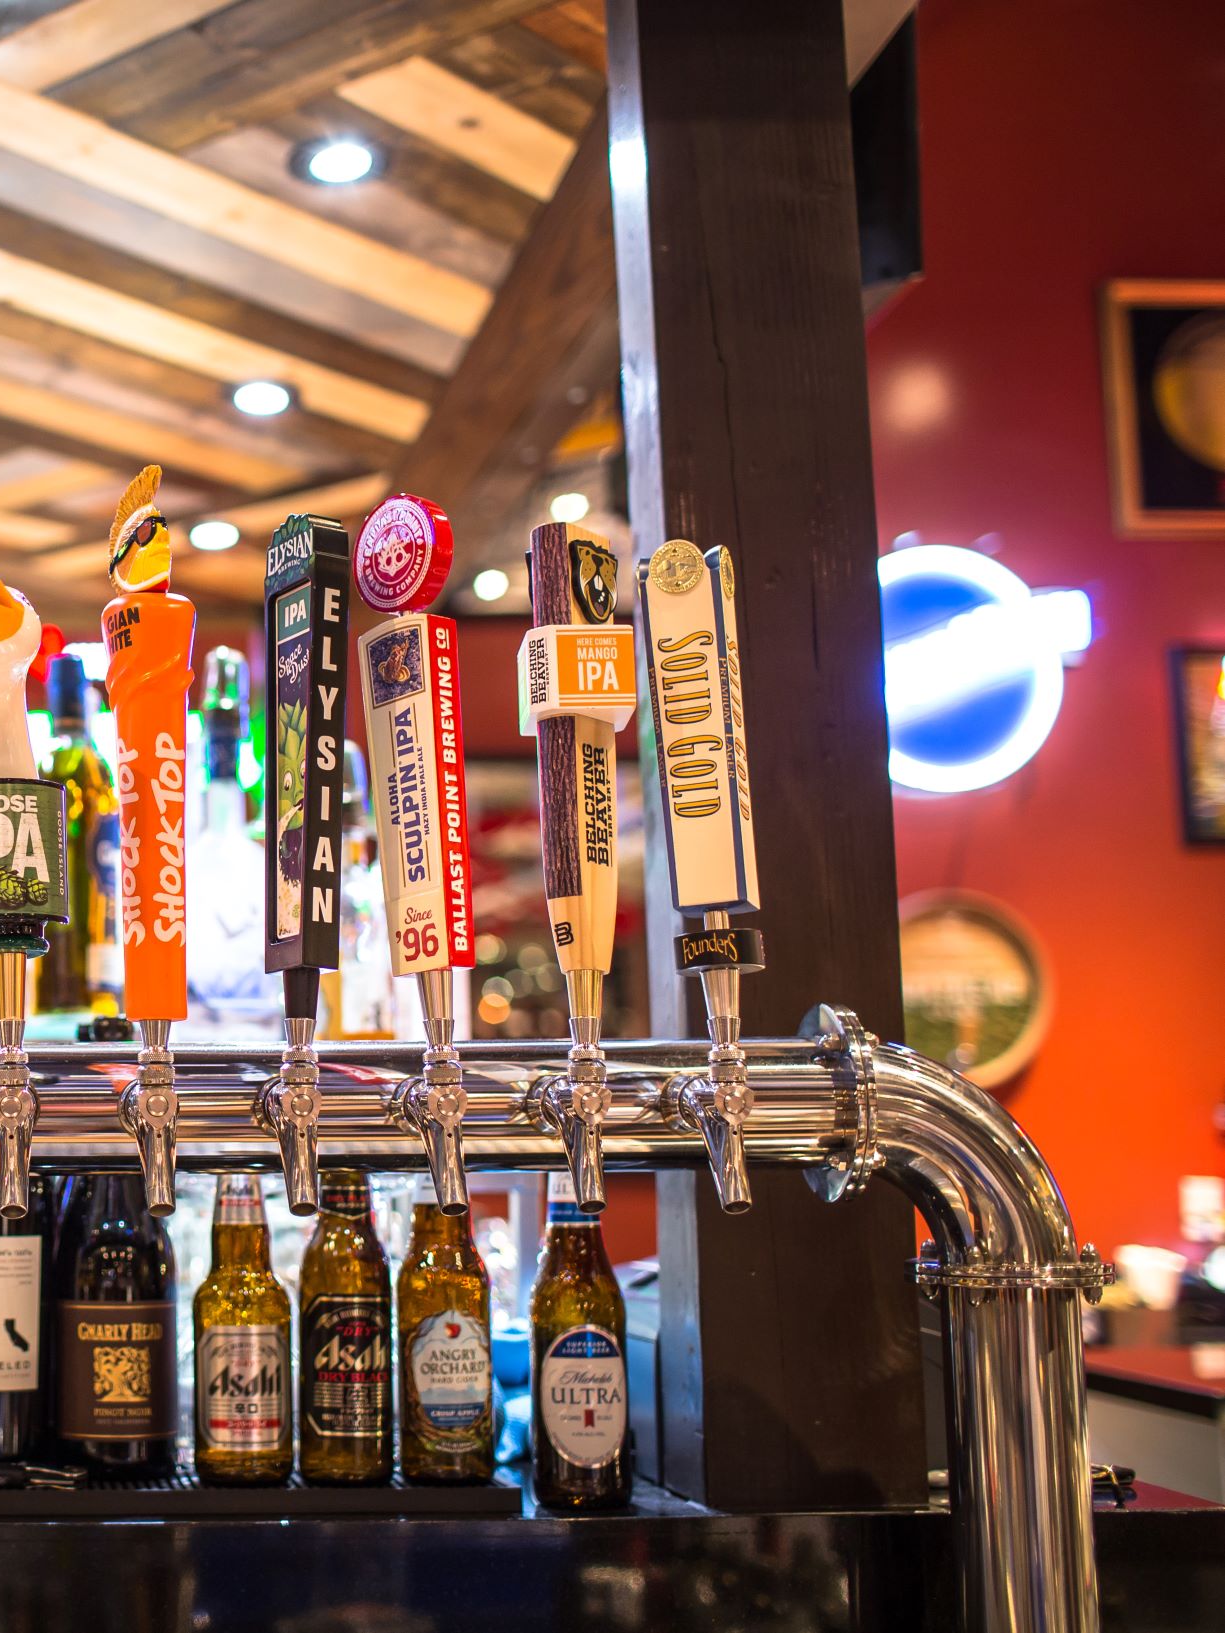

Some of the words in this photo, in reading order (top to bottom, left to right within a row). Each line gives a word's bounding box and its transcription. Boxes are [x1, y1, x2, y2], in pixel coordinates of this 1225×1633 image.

[268, 529, 313, 577] ELYSIAN
[396, 549, 424, 593] COMPANY
[365, 567, 394, 596] BREWING
[107, 606, 140, 634] GIAN
[284, 599, 307, 628] IPA
[278, 643, 303, 679] Space
[435, 627, 450, 650] CO
[576, 637, 593, 646] HERE
[594, 637, 617, 646] COMES
[577, 647, 618, 660] MANGO
[290, 648, 310, 684] Dust
[529, 639, 538, 705] BELCHING
[537, 637, 547, 703] BEAVER
[578, 661, 620, 691] IPA
[657, 630, 714, 725] SOLID
[395, 707, 415, 757] IPA
[438, 656, 458, 765] BREWING
[647, 667, 662, 736] PREMIUM
[656, 743, 668, 789] LAGER
[719, 657, 731, 724] PREMIUM
[725, 733, 736, 780] LAGER
[726, 633, 743, 729] SOLID
[735, 737, 751, 821] GOLD
[151, 732, 186, 815] TOP
[312, 587, 341, 924] ELYSIAN
[667, 734, 724, 818] GOLD
[387, 772, 401, 826] ALOHA
[399, 760, 426, 883] SCULPIN
[444, 771, 462, 843] POINT
[582, 742, 598, 864] BELCHING
[593, 747, 610, 867] BEAVER
[57, 853, 65, 896] ISLAND
[153, 815, 186, 948] SHOCK
[404, 906, 433, 925] Since
[448, 850, 468, 952] BALLAST
[317, 1372, 347, 1383] DRY
[420, 1361, 485, 1376] ORCHARD
[430, 1349, 477, 1361] ANGRY
[559, 1370, 613, 1385] Michelob
[208, 1364, 283, 1398] Asahi
[551, 1387, 622, 1405] ULTRA
